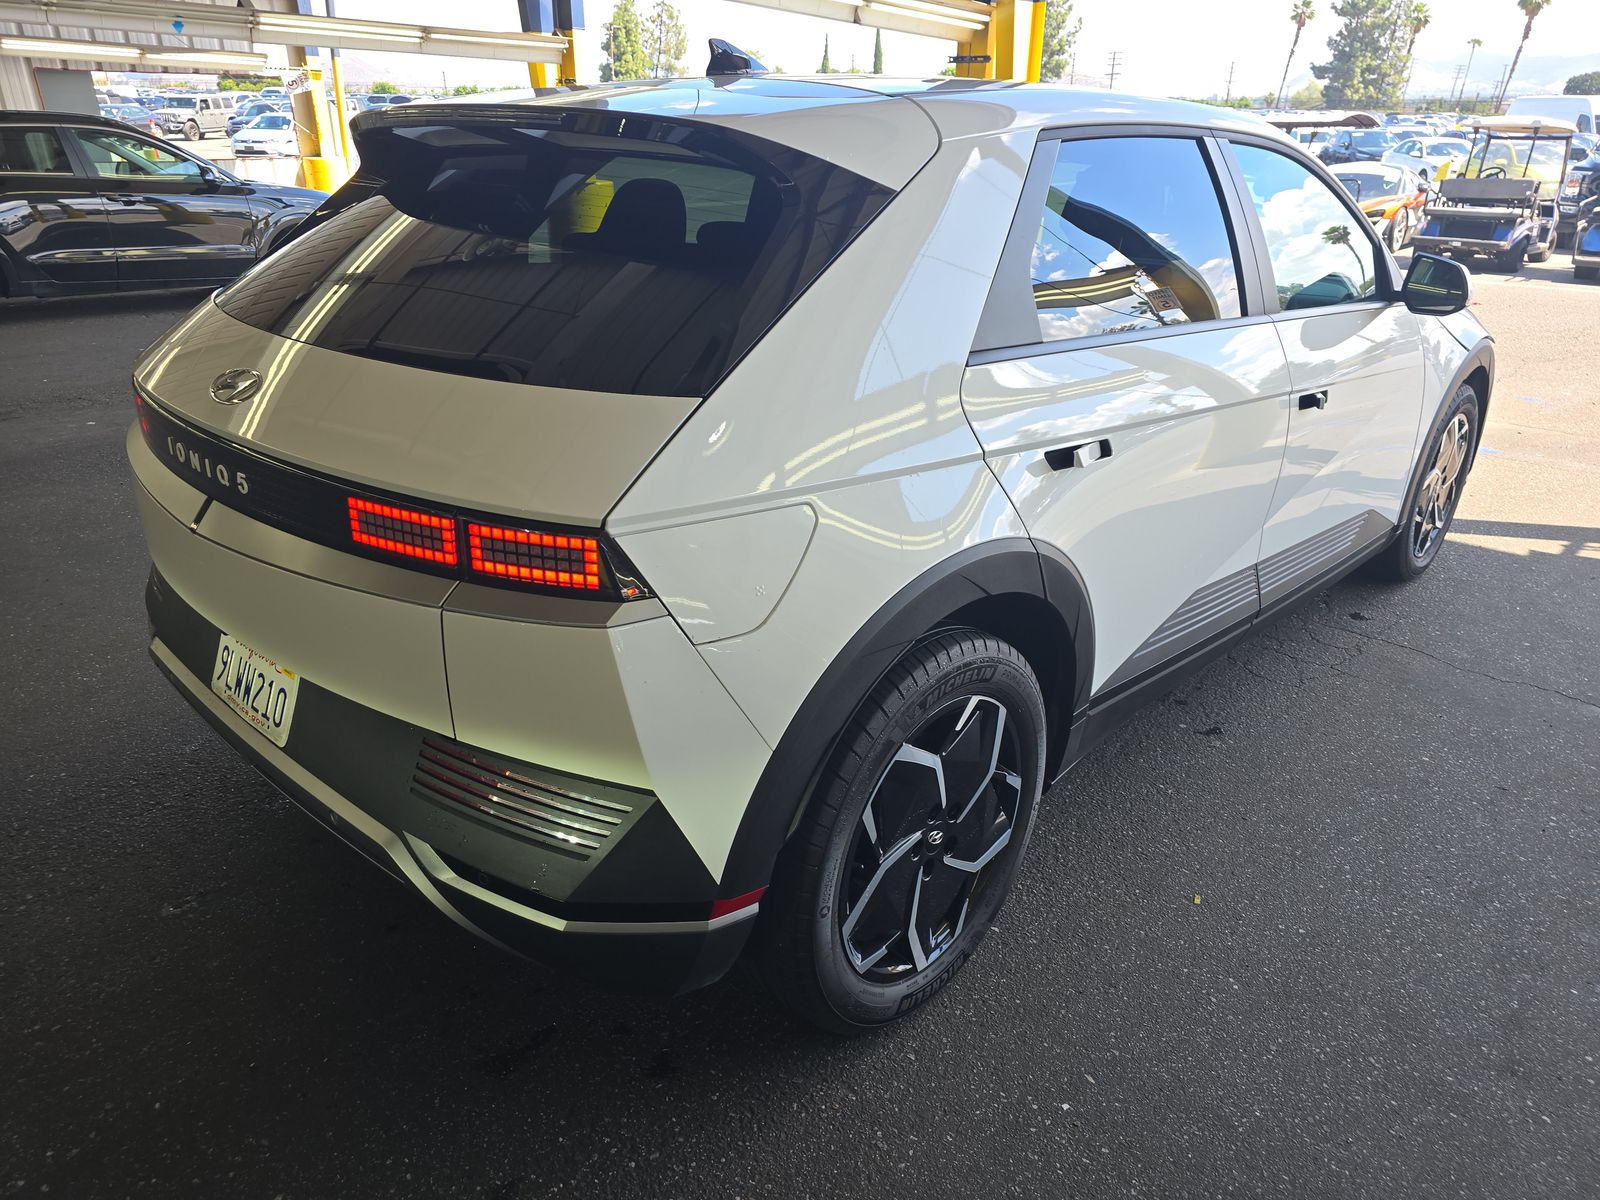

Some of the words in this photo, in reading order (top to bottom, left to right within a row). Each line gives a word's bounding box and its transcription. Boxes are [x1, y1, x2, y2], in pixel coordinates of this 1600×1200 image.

[167, 436, 229, 487] IONIQ
[236, 471, 249, 495] 5
[216, 645, 287, 728] 9LWW210
[227, 694, 265, 727] dmv.ca.gov
[926, 667, 995, 709] MICHELIN
